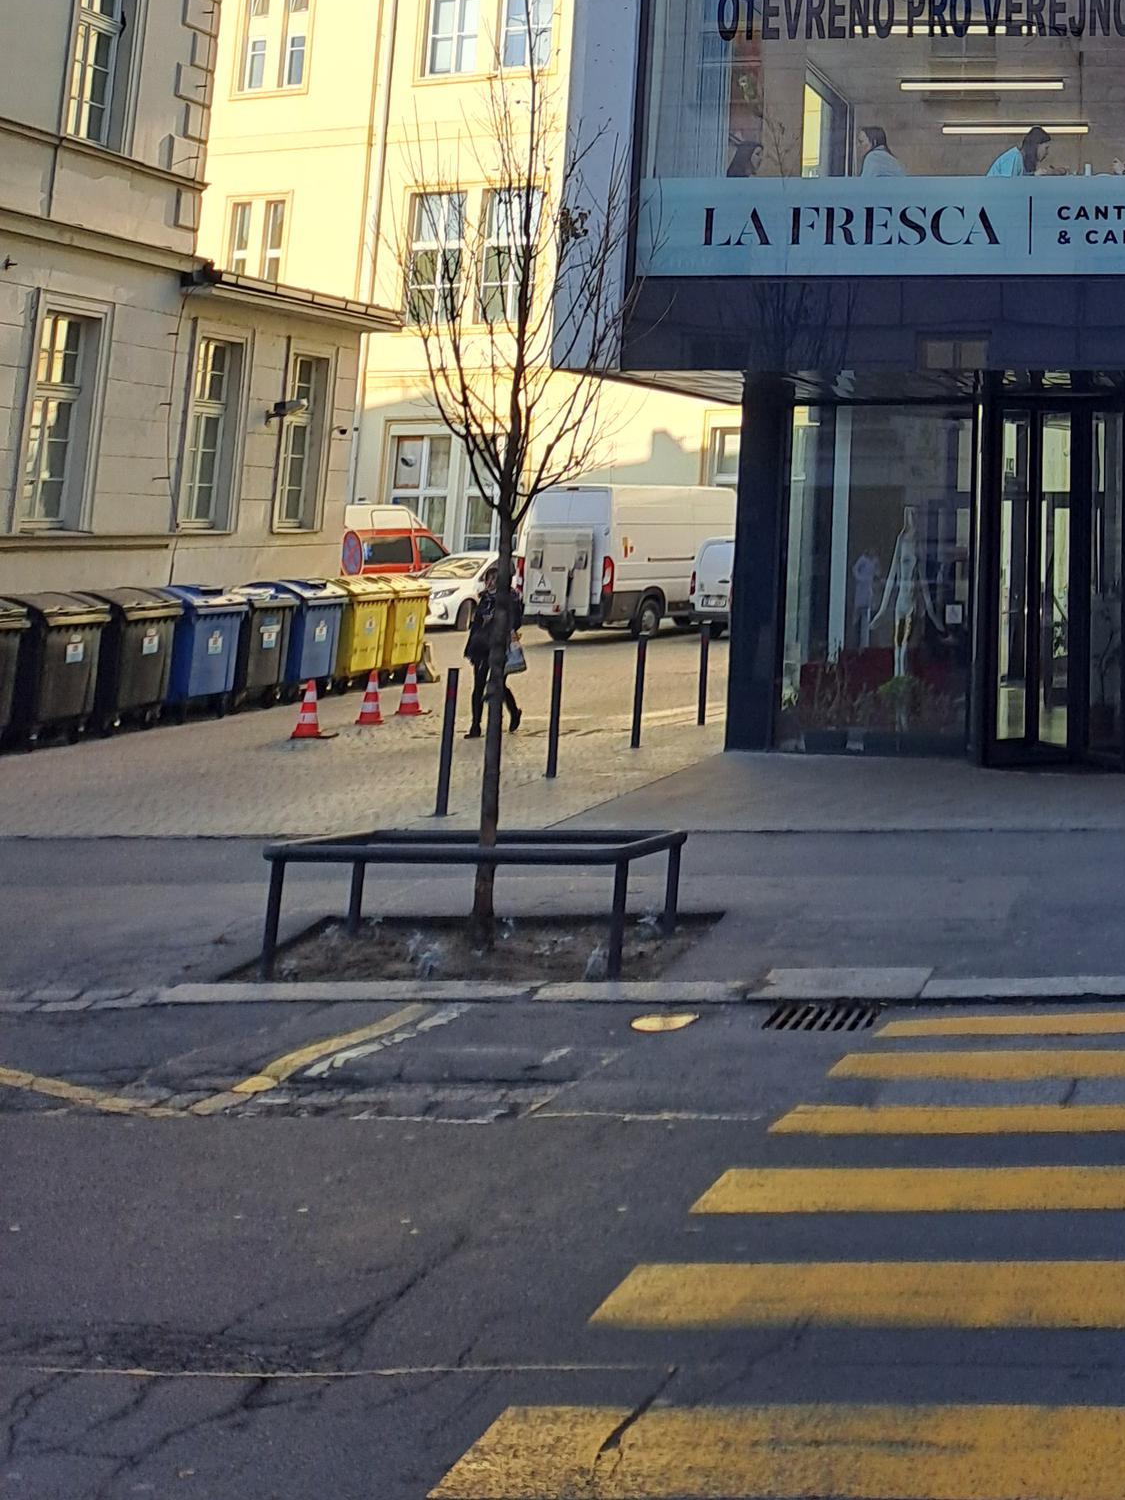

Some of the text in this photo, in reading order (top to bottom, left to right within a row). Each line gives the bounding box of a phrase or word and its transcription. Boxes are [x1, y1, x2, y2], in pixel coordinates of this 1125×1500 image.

[703, 206, 1001, 246] LA FRESCA
[1057, 230, 1071, 245] &
[537, 574, 547, 588] A
